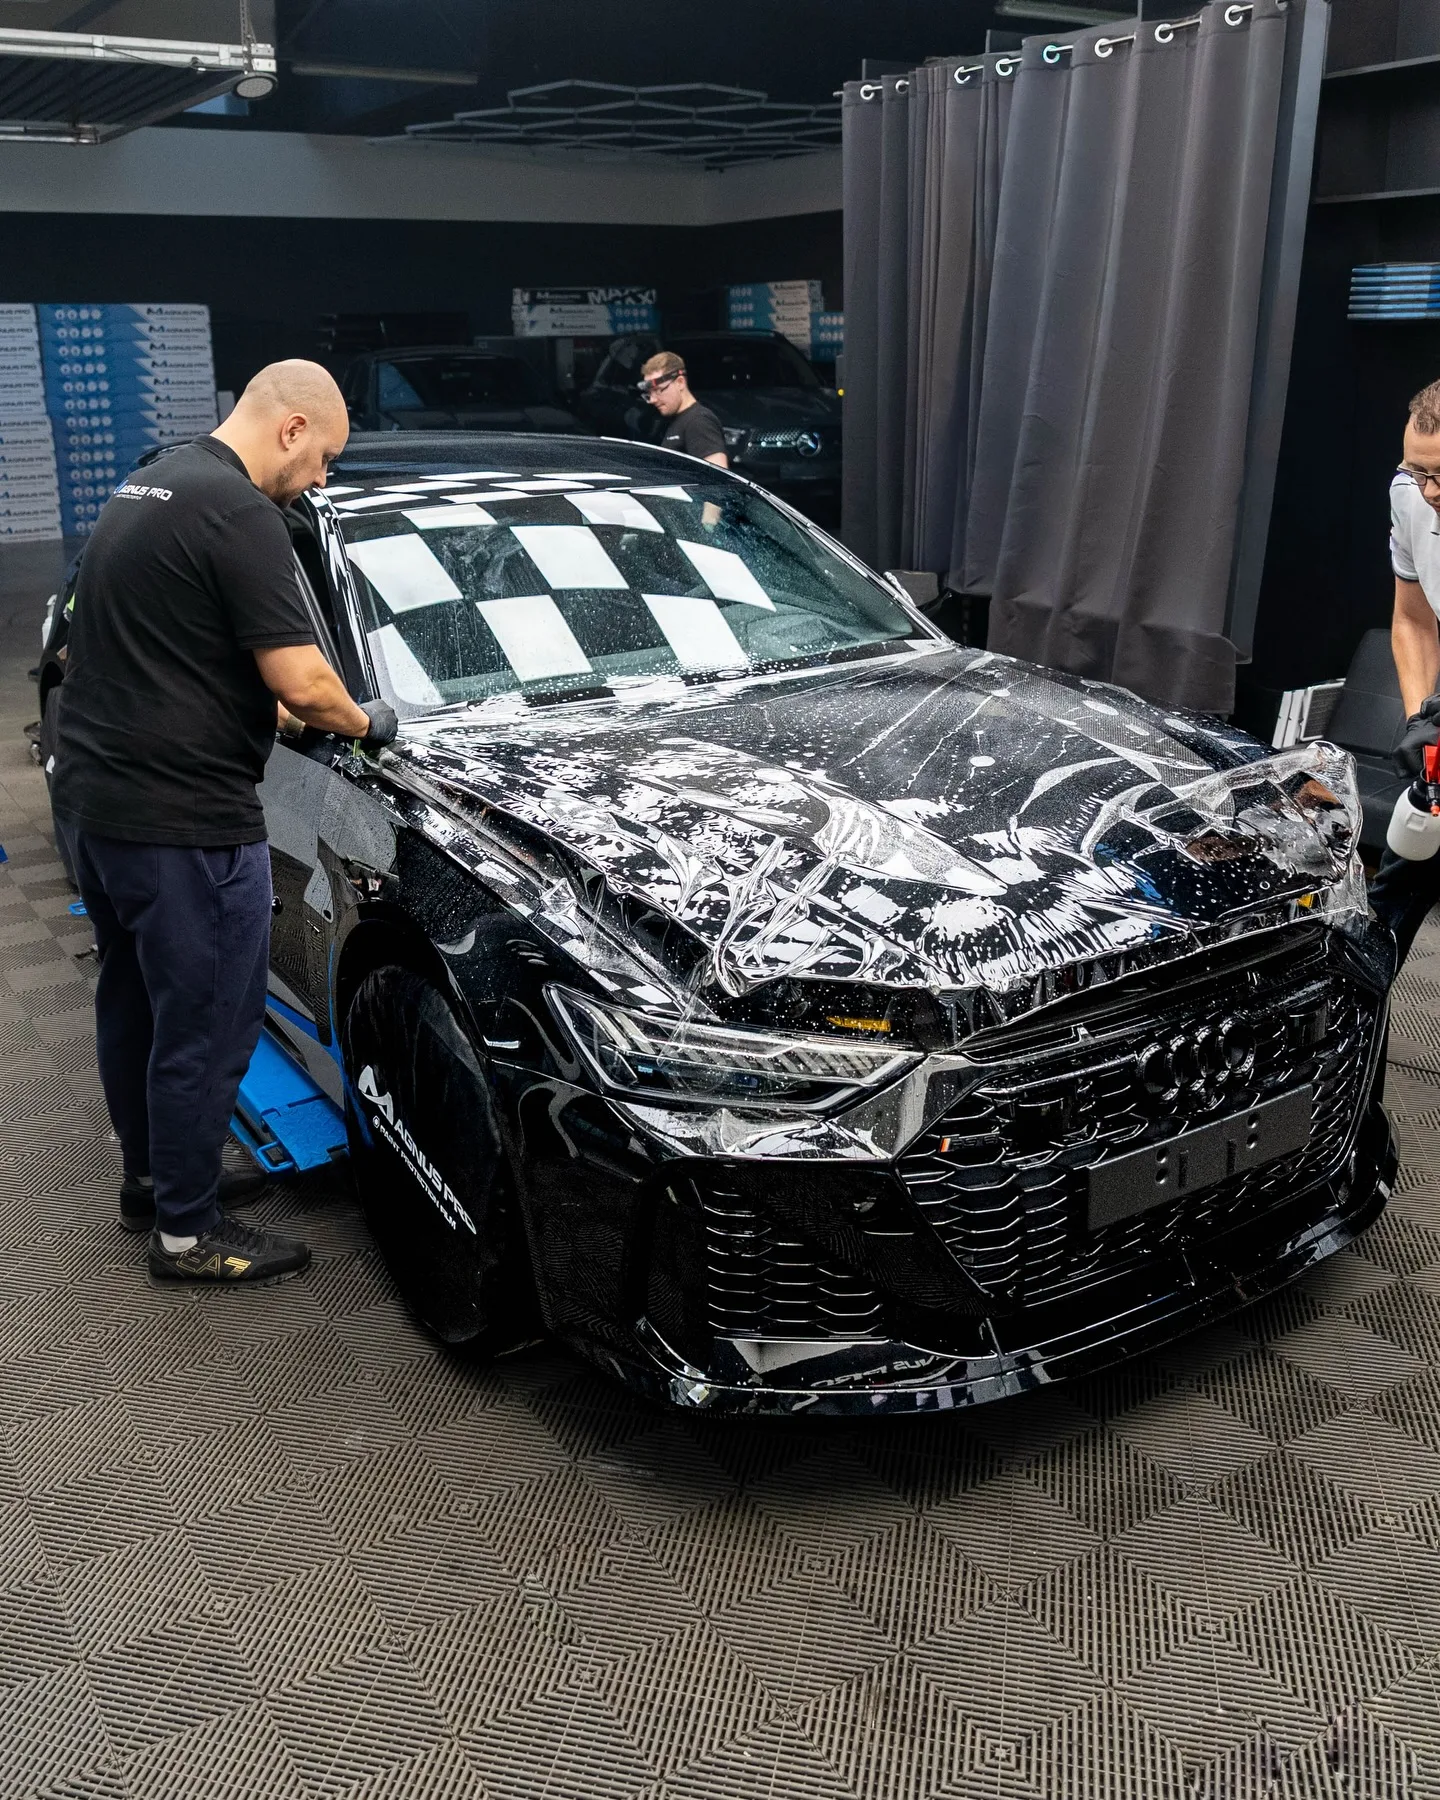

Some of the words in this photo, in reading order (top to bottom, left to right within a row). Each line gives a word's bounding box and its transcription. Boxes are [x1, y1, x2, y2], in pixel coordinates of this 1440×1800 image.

[147, 487, 173, 501] PRO
[380, 1125, 400, 1152] PAINT
[440, 1204, 456, 1230] FILM
[444, 1183, 477, 1235] PRO
[176, 1246, 252, 1278] EA7
